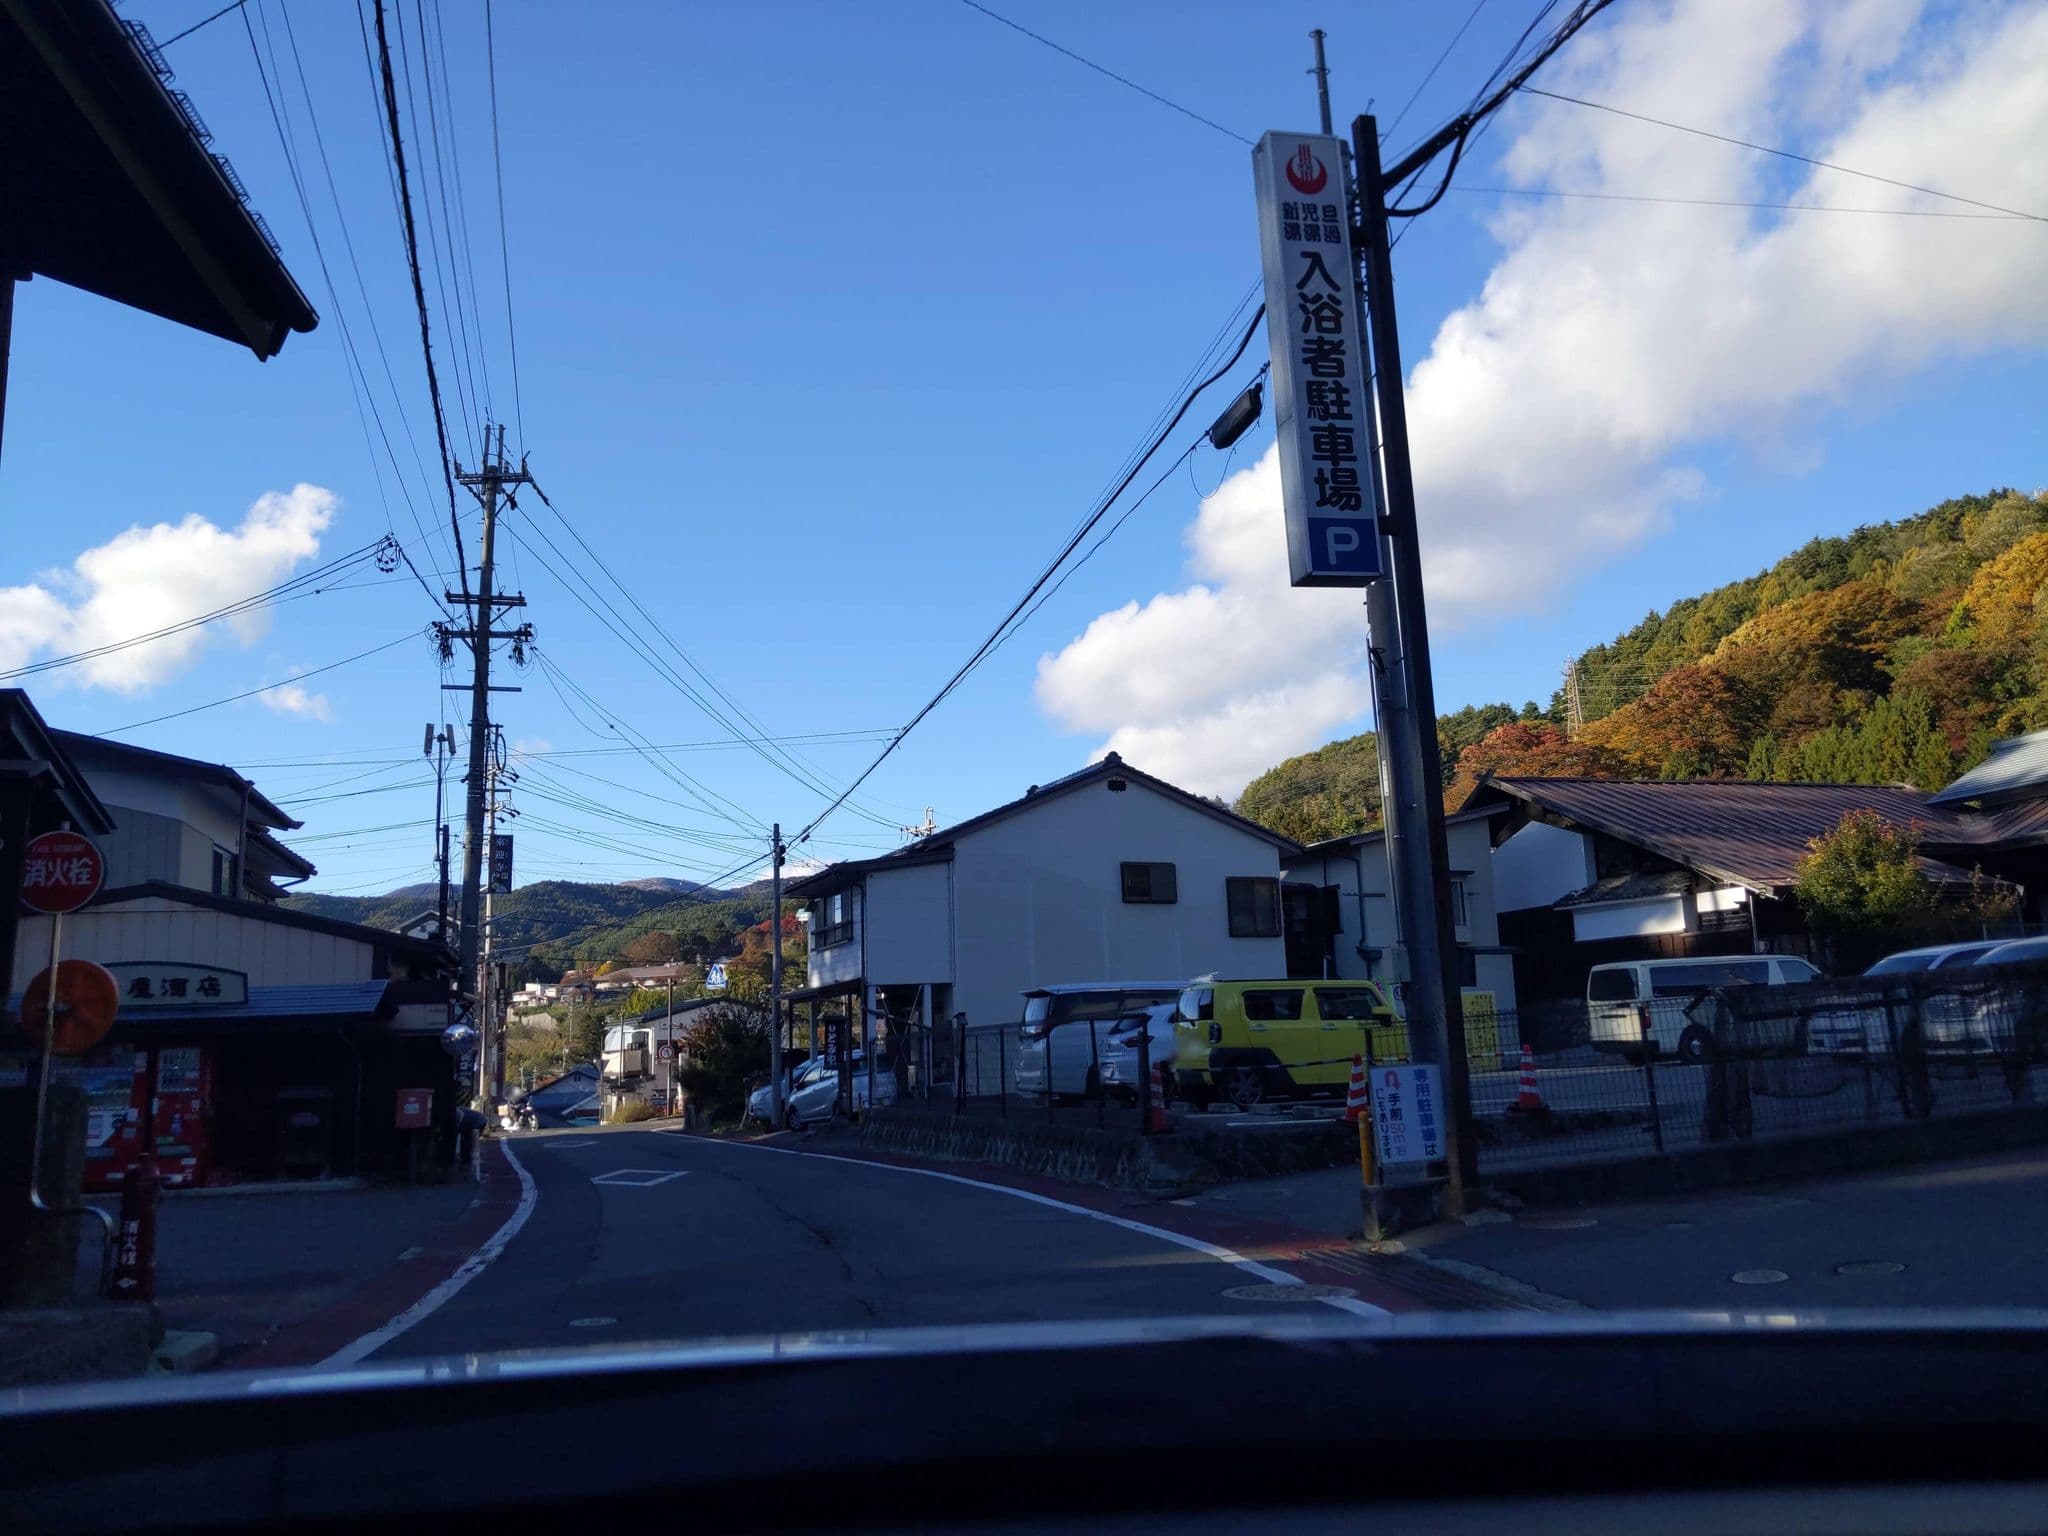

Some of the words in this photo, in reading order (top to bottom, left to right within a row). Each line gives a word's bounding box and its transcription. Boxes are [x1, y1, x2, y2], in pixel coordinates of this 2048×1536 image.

[1296, 251, 1362, 512] 入浴者駐車場
[1326, 526, 1360, 565] P
[23, 856, 93, 888] 消火栓
